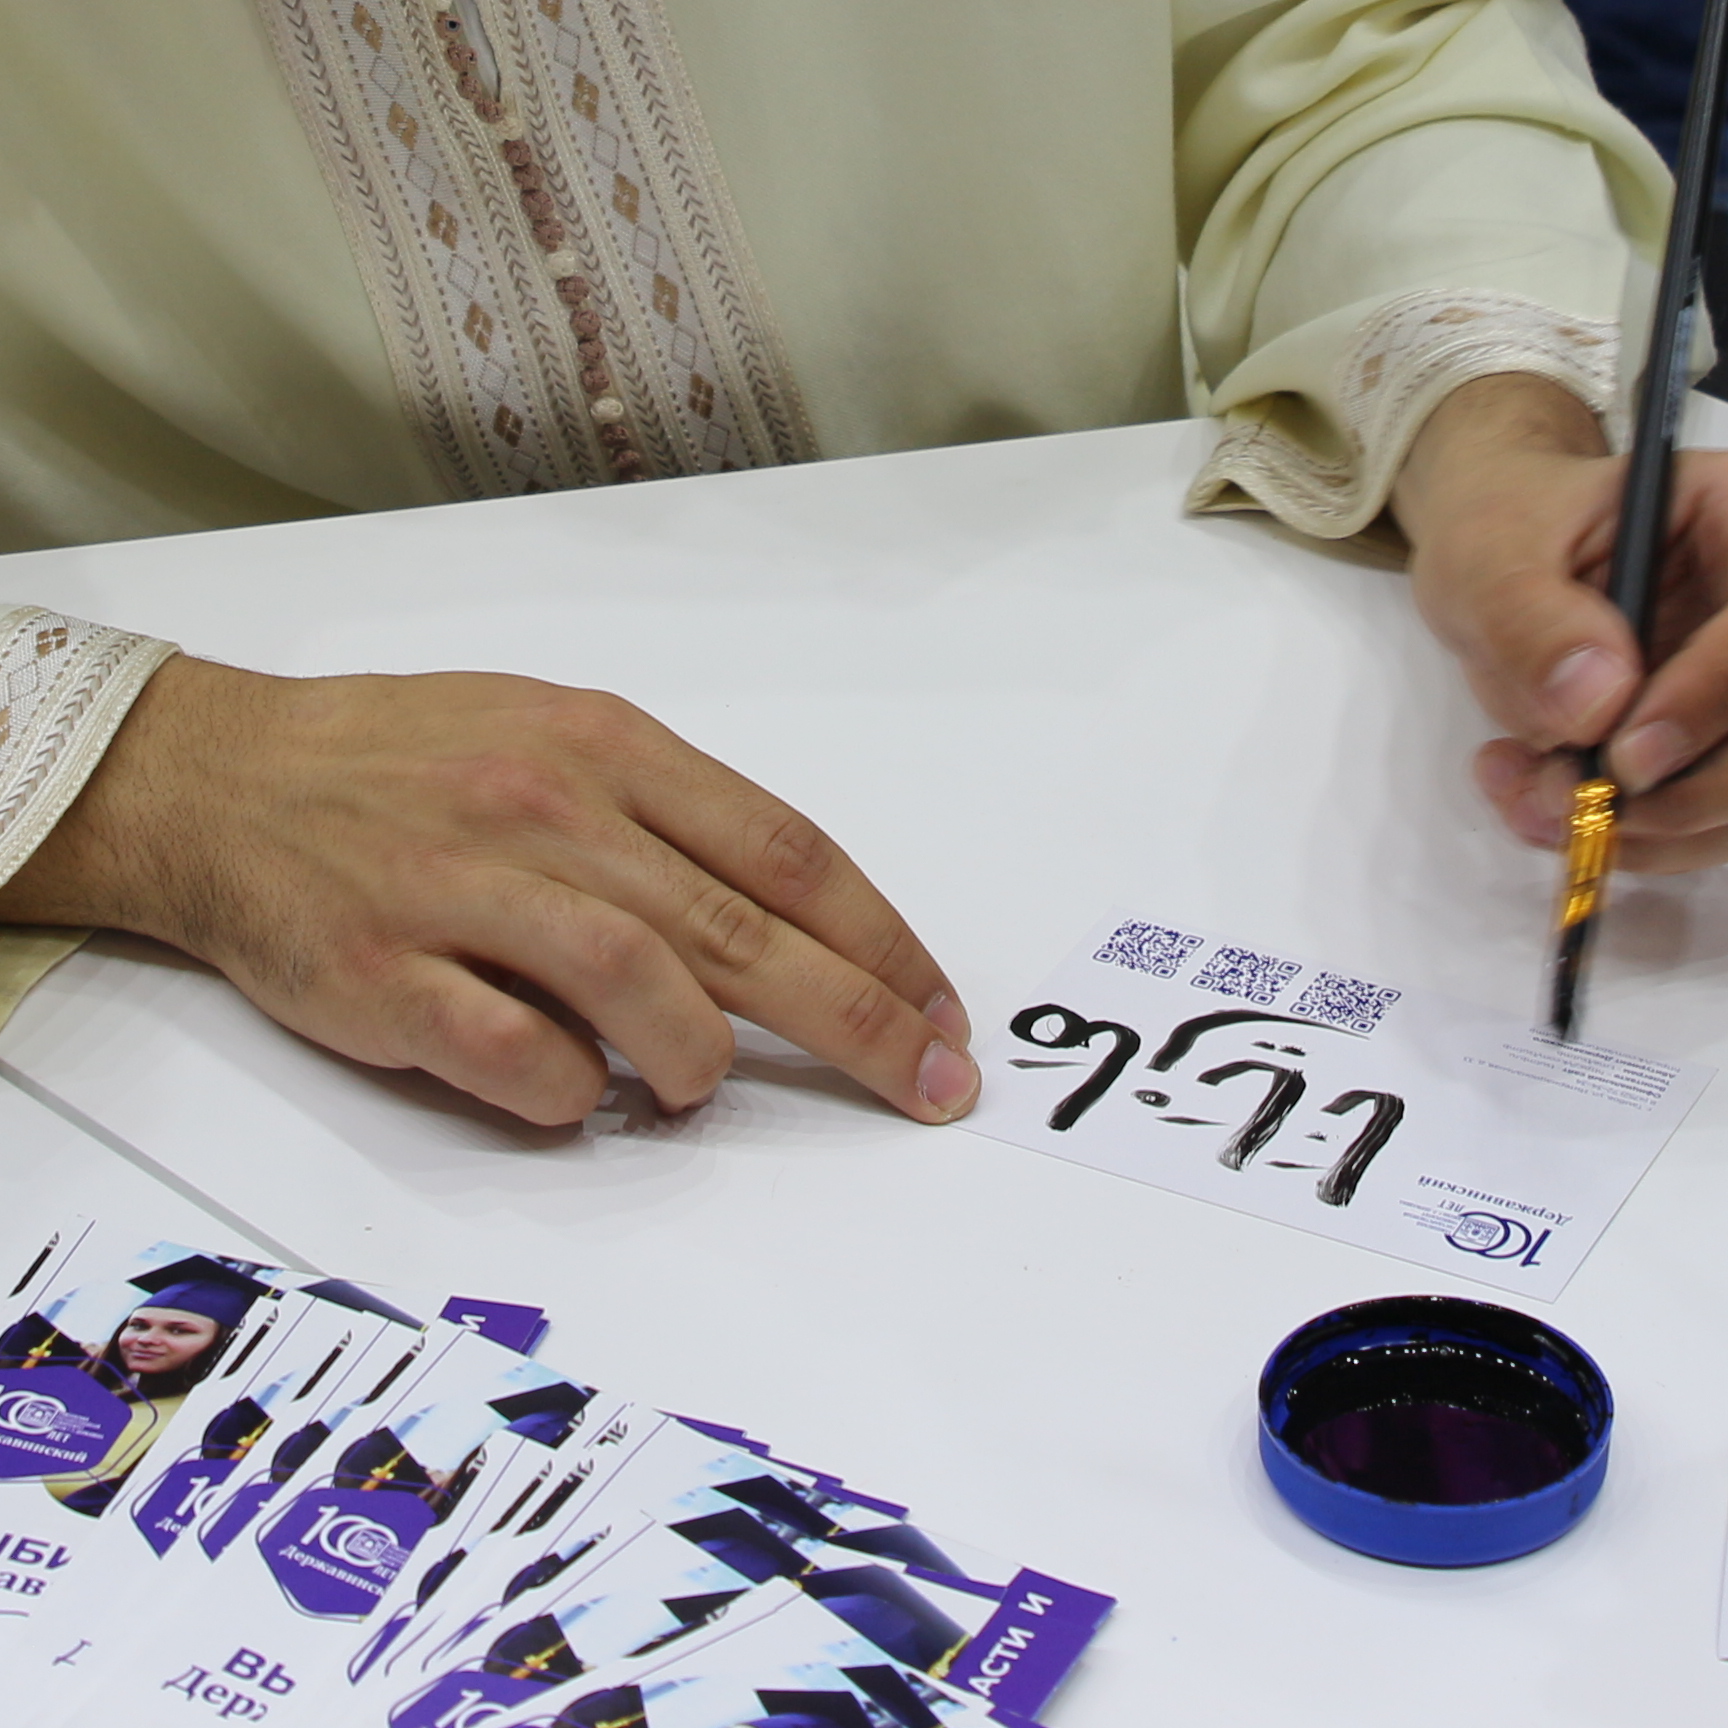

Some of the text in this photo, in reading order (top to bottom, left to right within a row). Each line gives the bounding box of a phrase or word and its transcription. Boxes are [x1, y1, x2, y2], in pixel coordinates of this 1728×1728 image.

[1417, 1175, 1574, 1227] Державинский
[1439, 1198, 1465, 1213] ЛЕТ
[45, 1431, 71, 1444] ЛЕТ
[1018, 1591, 1054, 1616] И
